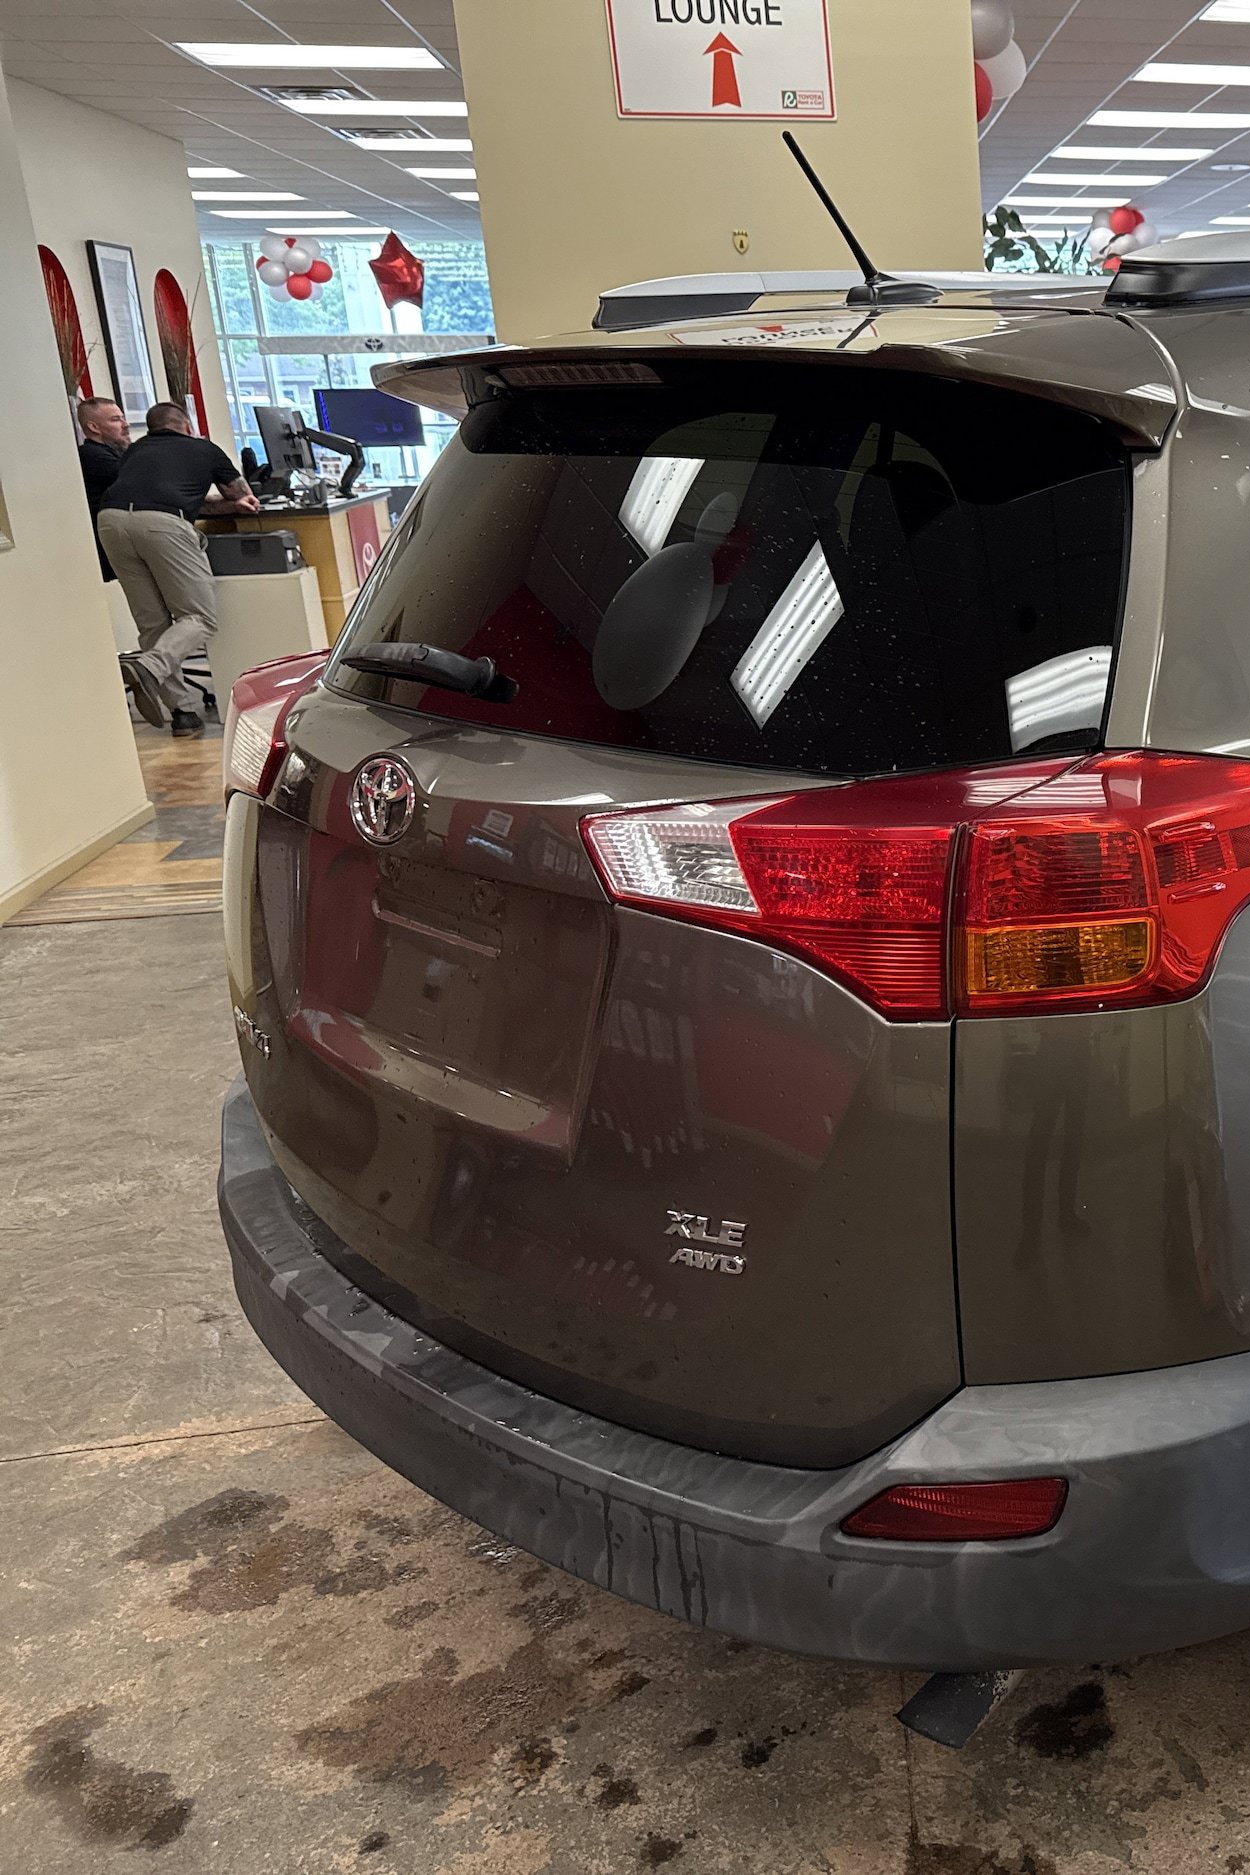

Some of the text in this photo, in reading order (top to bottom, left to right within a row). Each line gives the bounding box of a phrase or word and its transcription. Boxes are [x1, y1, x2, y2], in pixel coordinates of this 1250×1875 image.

[654, 0, 782, 26] LOUNGE
[663, 1209, 747, 1248] XLE
[668, 1247, 747, 1275] AWD
